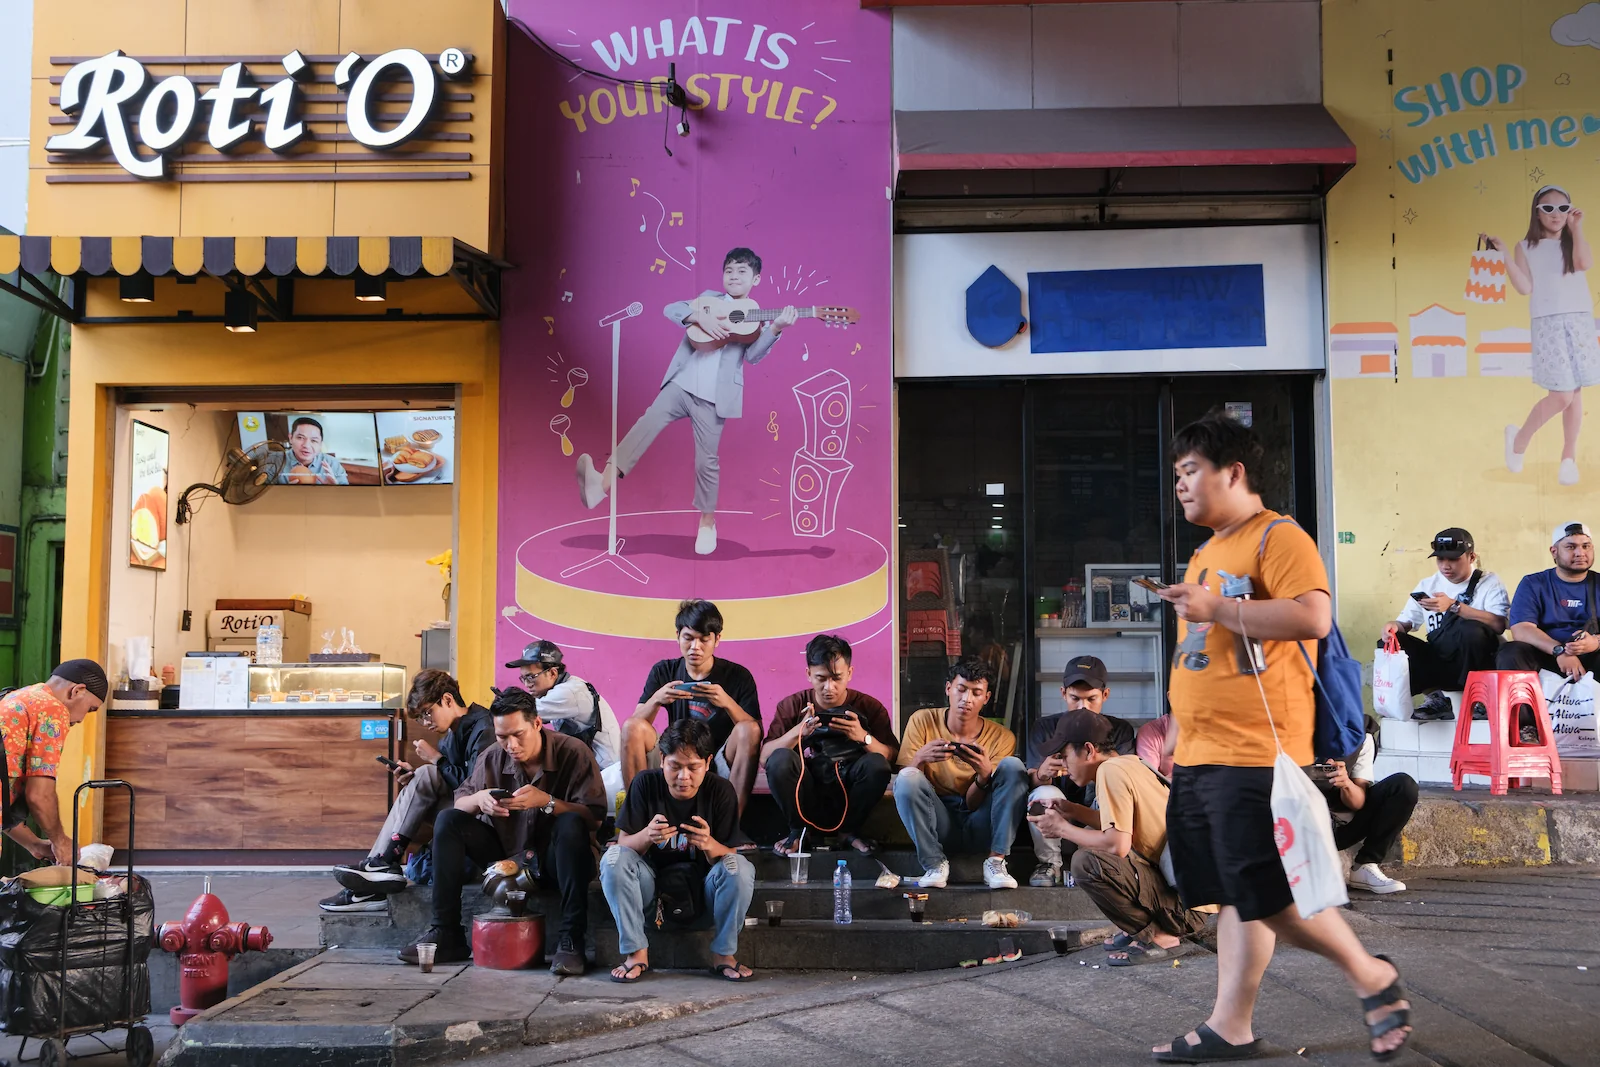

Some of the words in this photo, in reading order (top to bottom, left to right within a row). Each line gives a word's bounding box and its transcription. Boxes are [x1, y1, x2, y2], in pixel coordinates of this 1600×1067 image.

[591, 16, 742, 72] WHAT
[744, 24, 797, 70] IS
[45, 50, 306, 178] Roti
[559, 75, 674, 133] YOUR
[685, 73, 838, 131] STYLE?
[1394, 63, 1527, 127] SHOP
[1506, 115, 1580, 151] me
[1551, 708, 1581, 720] Aliva
[1552, 694, 1581, 706] Aliva
[1553, 723, 1581, 734] Aliva
